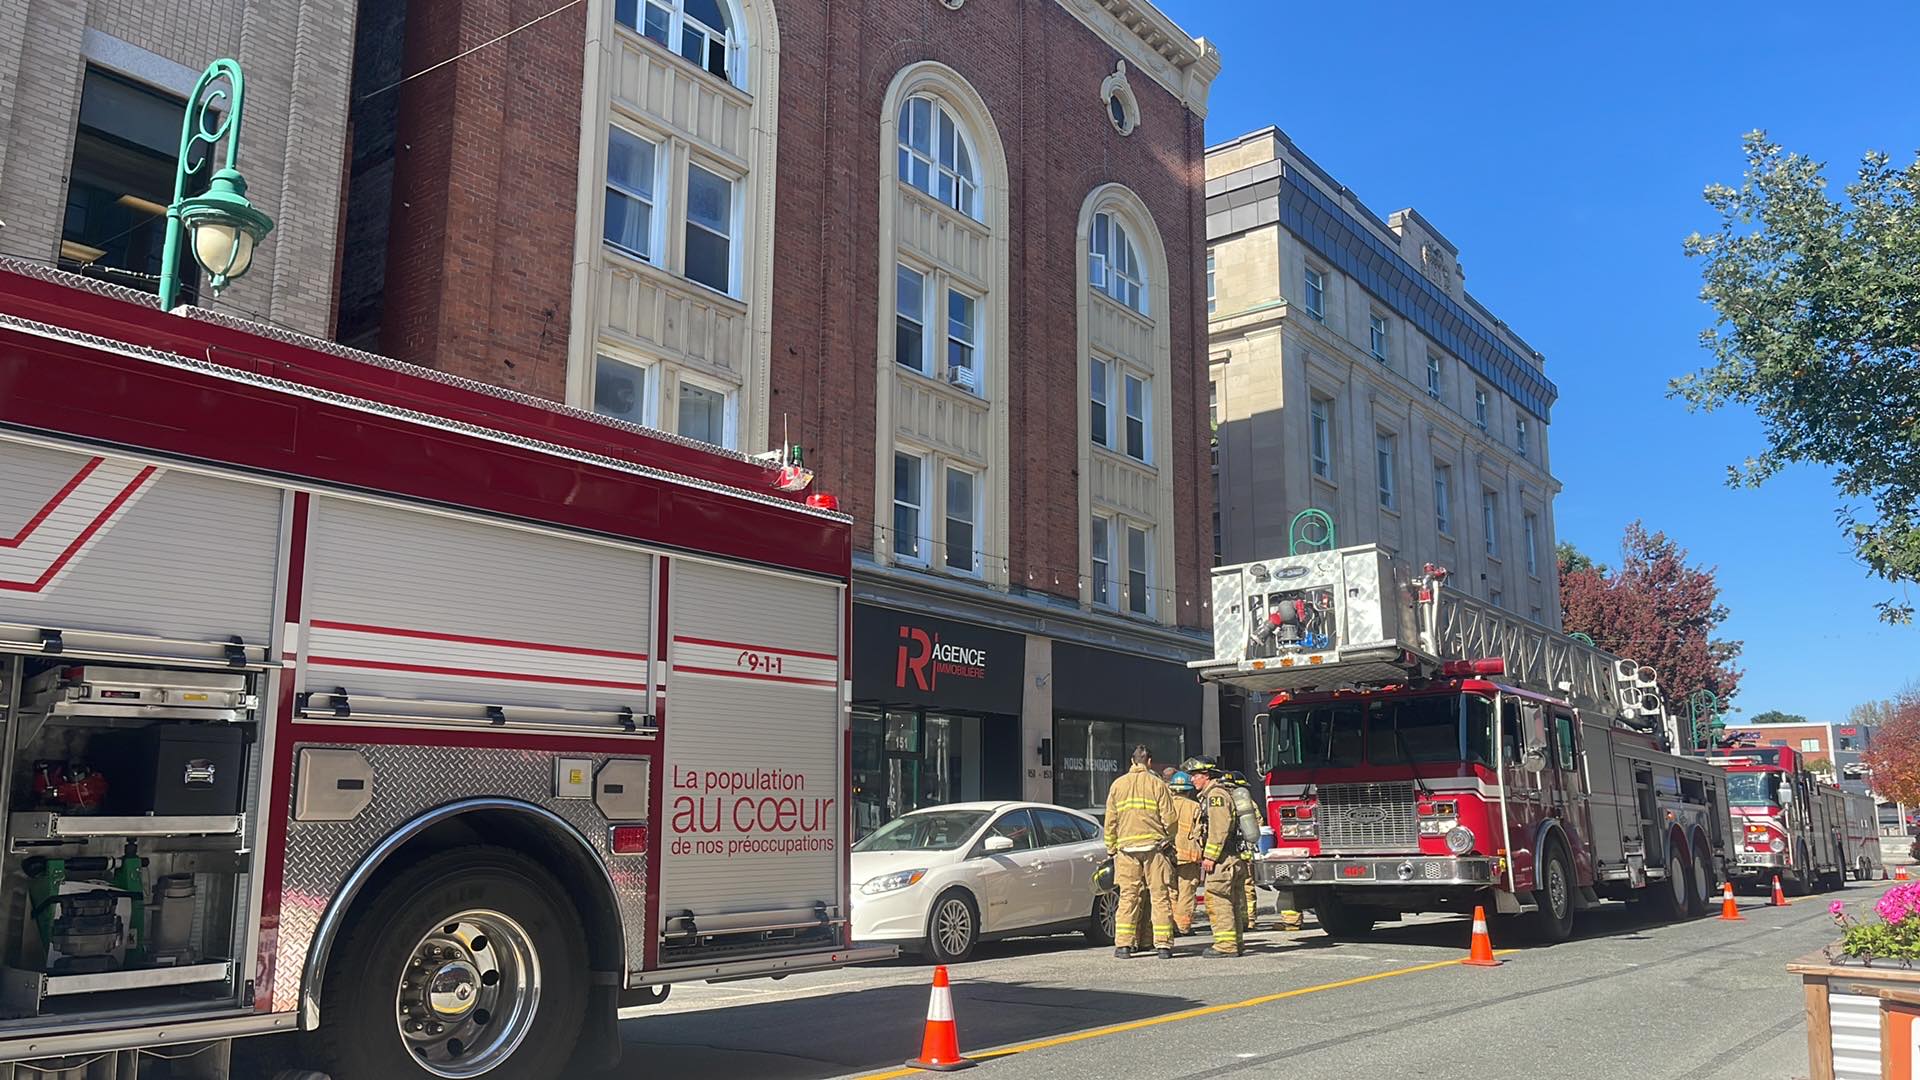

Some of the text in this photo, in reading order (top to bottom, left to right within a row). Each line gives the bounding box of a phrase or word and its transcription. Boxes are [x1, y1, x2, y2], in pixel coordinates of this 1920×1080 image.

[748, 653, 782, 674] 9-1-1
[932, 643, 986, 667] AGENCE
[896, 736, 908, 749] 151
[1840, 728, 1857, 736] CGI
[1063, 757, 1084, 770] NOUS
[673, 765, 805, 795] La population
[1210, 797, 1222, 807] 34
[671, 796, 834, 833] au cœur
[671, 835, 834, 857] de nos préoccupations
